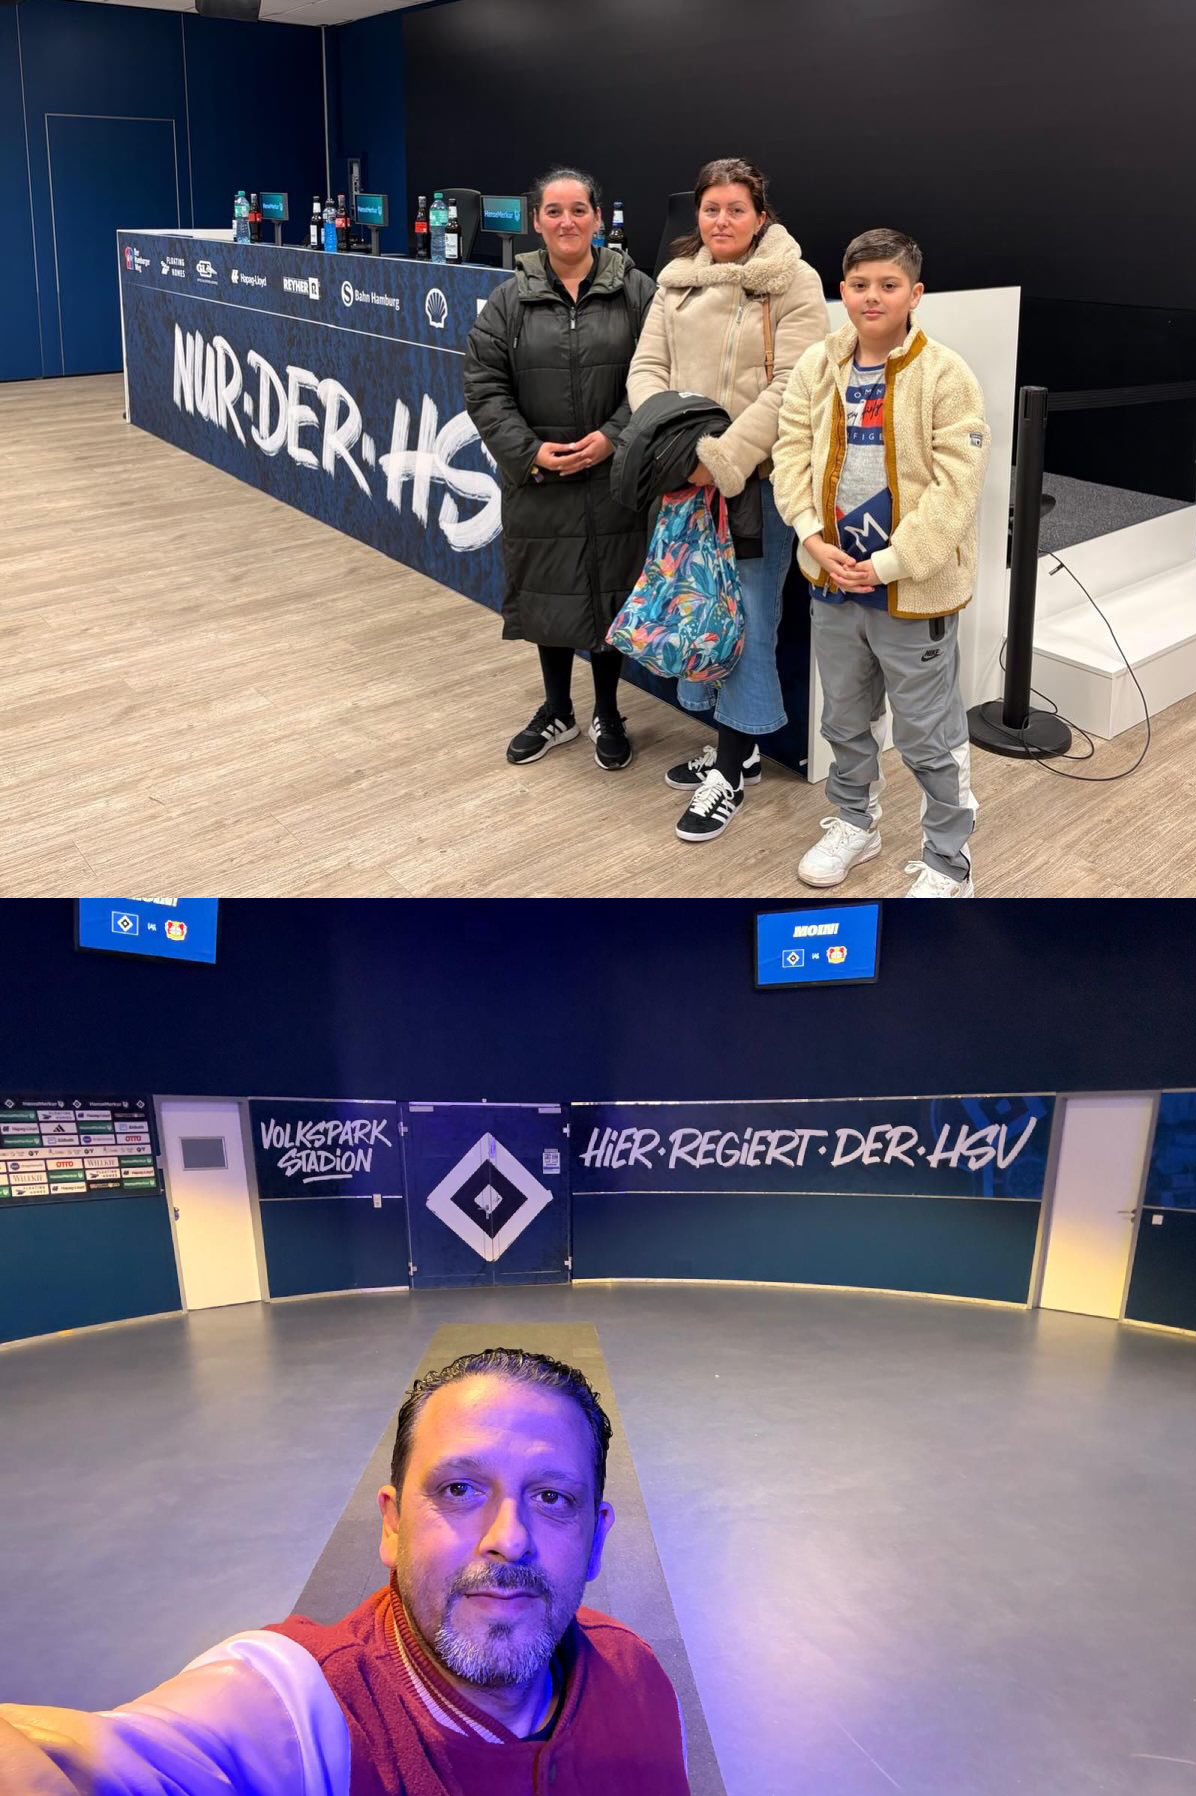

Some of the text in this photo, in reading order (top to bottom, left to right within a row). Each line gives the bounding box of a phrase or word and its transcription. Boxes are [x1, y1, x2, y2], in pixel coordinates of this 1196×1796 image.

[240, 273, 267, 287] Hapag-Lloyd
[355, 289, 370, 303] Bahn
[371, 291, 400, 310] Hamburg
[174, 322, 246, 447] NUR
[247, 350, 372, 498] DER
[261, 1118, 392, 1149] VOLKSPARK
[831, 1124, 918, 1168] DER
[926, 1116, 1037, 1171] HSV
